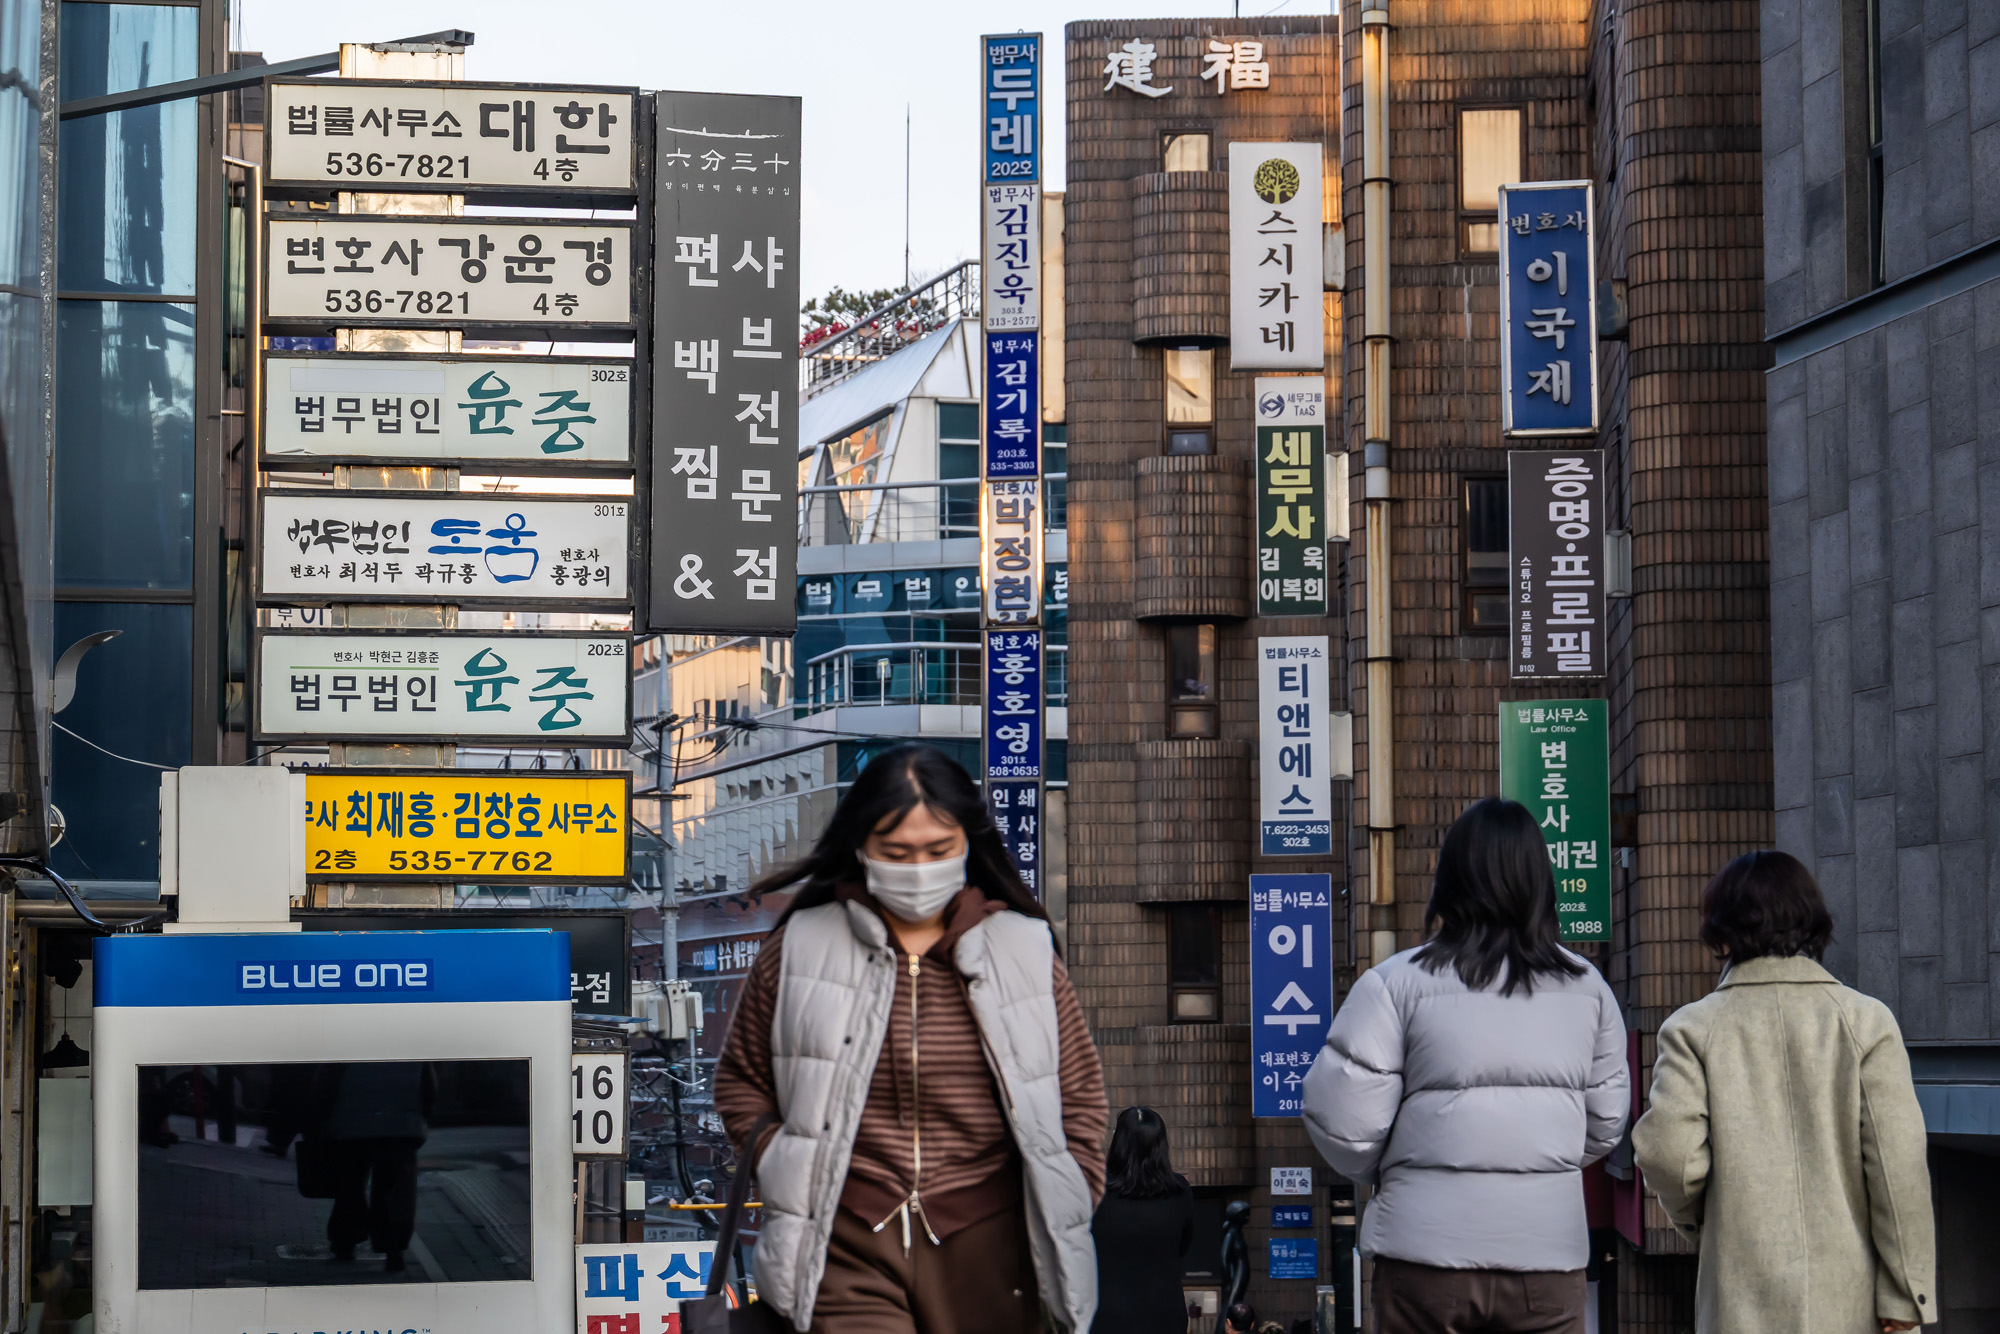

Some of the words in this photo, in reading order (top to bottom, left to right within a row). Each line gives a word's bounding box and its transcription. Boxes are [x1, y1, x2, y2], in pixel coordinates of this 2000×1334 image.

[989, 43, 1036, 65] 법무사
[989, 68, 1035, 155] 두레
[288, 104, 463, 138] 법률사무소
[479, 100, 618, 155] 대한
[326, 152, 470, 179] 536-7821
[533, 157, 580, 182] 4층
[991, 160, 1033, 176] 202호
[989, 186, 1035, 203] 법무사
[1510, 211, 1587, 235] 변호사
[286, 236, 423, 276] 변호사
[438, 234, 613, 287] 강윤경
[993, 204, 1033, 305] 김진욱
[1257, 210, 1300, 353] 스시카네
[324, 289, 469, 315] 536-7821
[533, 292, 580, 316] 4층
[1001, 307, 1024, 315] 303호
[989, 316, 1036, 326] 313-2577
[1524, 251, 1576, 405] 이국재
[991, 339, 1034, 354] 법무사
[591, 370, 628, 383] 302호
[295, 396, 440, 434] 법무법인
[457, 370, 597, 454] 윤중
[993, 360, 1032, 443] 김기록
[997, 448, 1028, 458] 203호
[990, 461, 1035, 471] 535-3303
[992, 481, 1036, 495] 변호사
[1264, 432, 1316, 539] 세무사
[594, 504, 625, 517] 301호
[287, 518, 411, 556] 법무법인
[427, 512, 540, 584] 도움
[560, 548, 600, 563] 변호사
[994, 497, 1035, 610] 박정현
[290, 564, 330, 579] 변호사
[339, 562, 403, 583] 최석두
[415, 563, 478, 585] 곽규홍
[550, 565, 611, 587] 홍광의
[1520, 556, 1533, 603] 스튜디오
[1260, 578, 1324, 602] 이복희
[587, 643, 625, 657] 202호
[990, 634, 1040, 651] 변호사
[1265, 647, 1321, 659] 법률사무소
[333, 651, 363, 663] 변호사
[369, 650, 403, 664] 박현근
[406, 651, 440, 664] 김흥준
[290, 674, 437, 712] 법무법인
[454, 647, 594, 731] 윤중
[992, 653, 1036, 753] 홍호영
[1518, 708, 1588, 723] 법률사무소
[1277, 663, 1314, 815] 티앤에스
[1530, 725, 1547, 733] Law
[1551, 725, 1576, 733] Office
[989, 766, 1039, 776] 508-0635
[1001, 755, 1027, 765] 301호
[1540, 741, 1570, 833] 변호사
[548, 801, 618, 834] 사무소
[1282, 837, 1311, 847] 302호
[315, 849, 358, 870] 2층
[388, 850, 553, 872] 535-7762
[1546, 840, 1597, 869] 재권
[1560, 878, 1587, 893] 119
[1253, 889, 1329, 912] 법률사무소
[1559, 902, 1587, 912] 202호
[1263, 924, 1321, 1036] 이수
[1260, 1051, 1319, 1067] 대표변호
[1263, 1071, 1302, 1092] 이수
